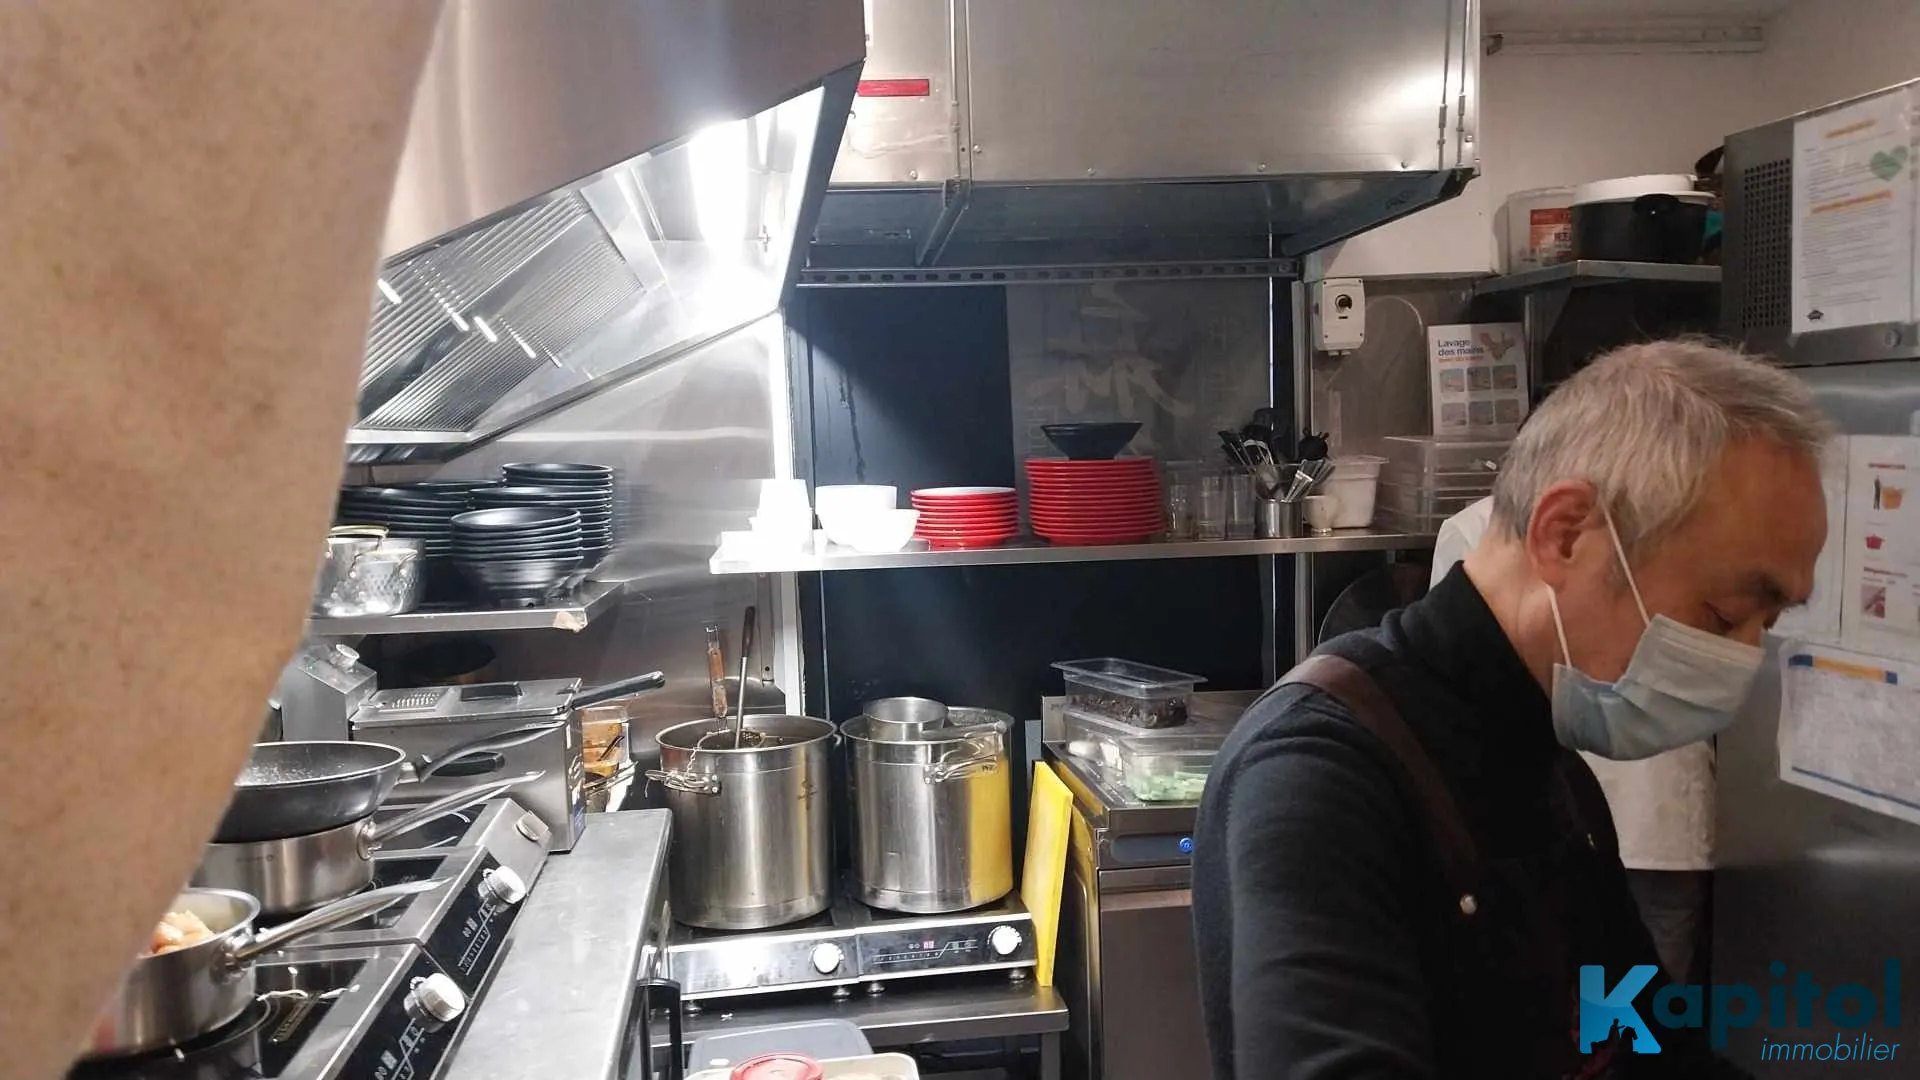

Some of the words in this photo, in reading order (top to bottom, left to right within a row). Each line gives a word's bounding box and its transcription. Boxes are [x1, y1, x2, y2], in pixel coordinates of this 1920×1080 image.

[1438, 339, 1470, 348] Lavage
[1438, 348, 1456, 356] des
[1456, 347, 1485, 355] mains
